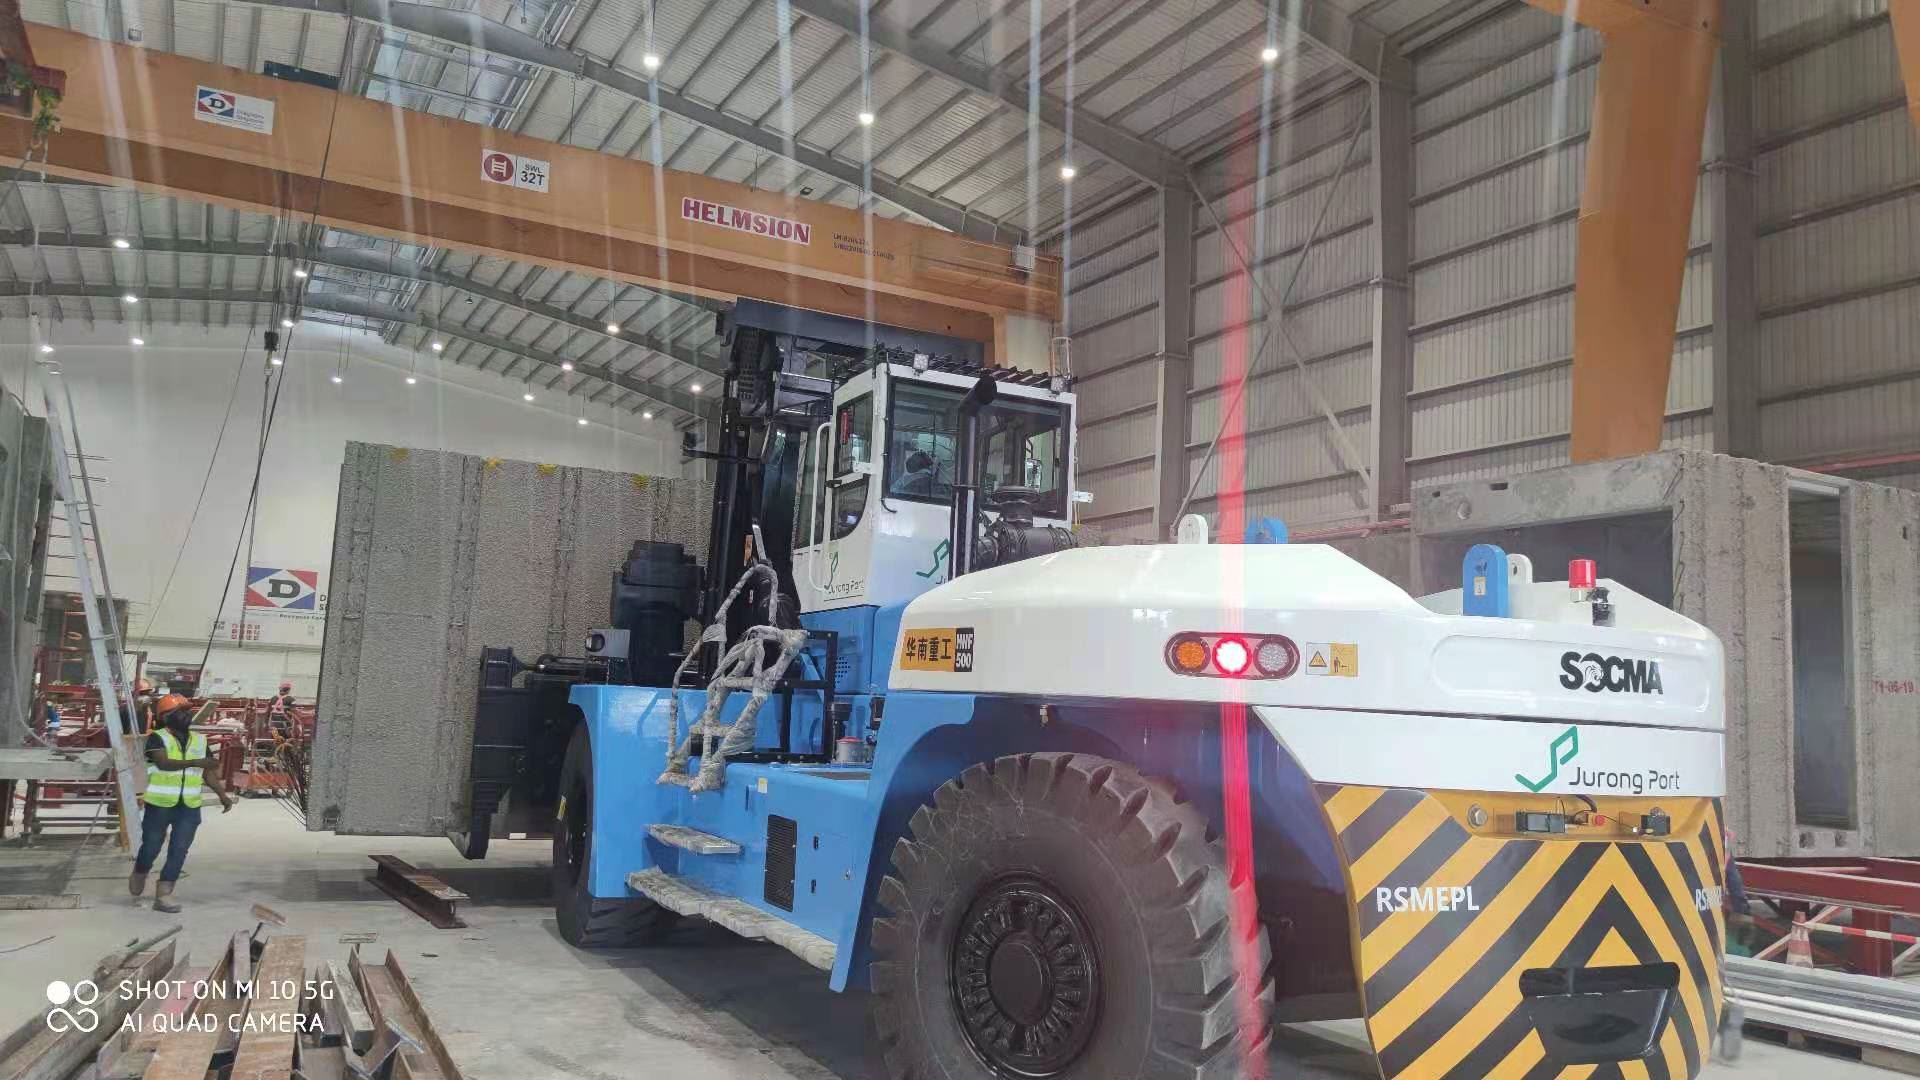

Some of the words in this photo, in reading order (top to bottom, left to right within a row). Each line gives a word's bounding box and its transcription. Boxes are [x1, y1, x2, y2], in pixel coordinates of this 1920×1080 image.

[208, 97, 226, 110] D
[520, 171, 545, 186] 32T
[525, 163, 543, 174] SWL
[683, 198, 810, 243] HELMSION
[267, 578, 301, 599] D
[905, 636, 952, 662] 华南重工
[955, 652, 971, 668] 500
[1559, 651, 1663, 695] SOCMA
[1568, 766, 1643, 795] Jurong
[1648, 769, 1681, 790] Port
[1376, 885, 1480, 912] RSMEPL
